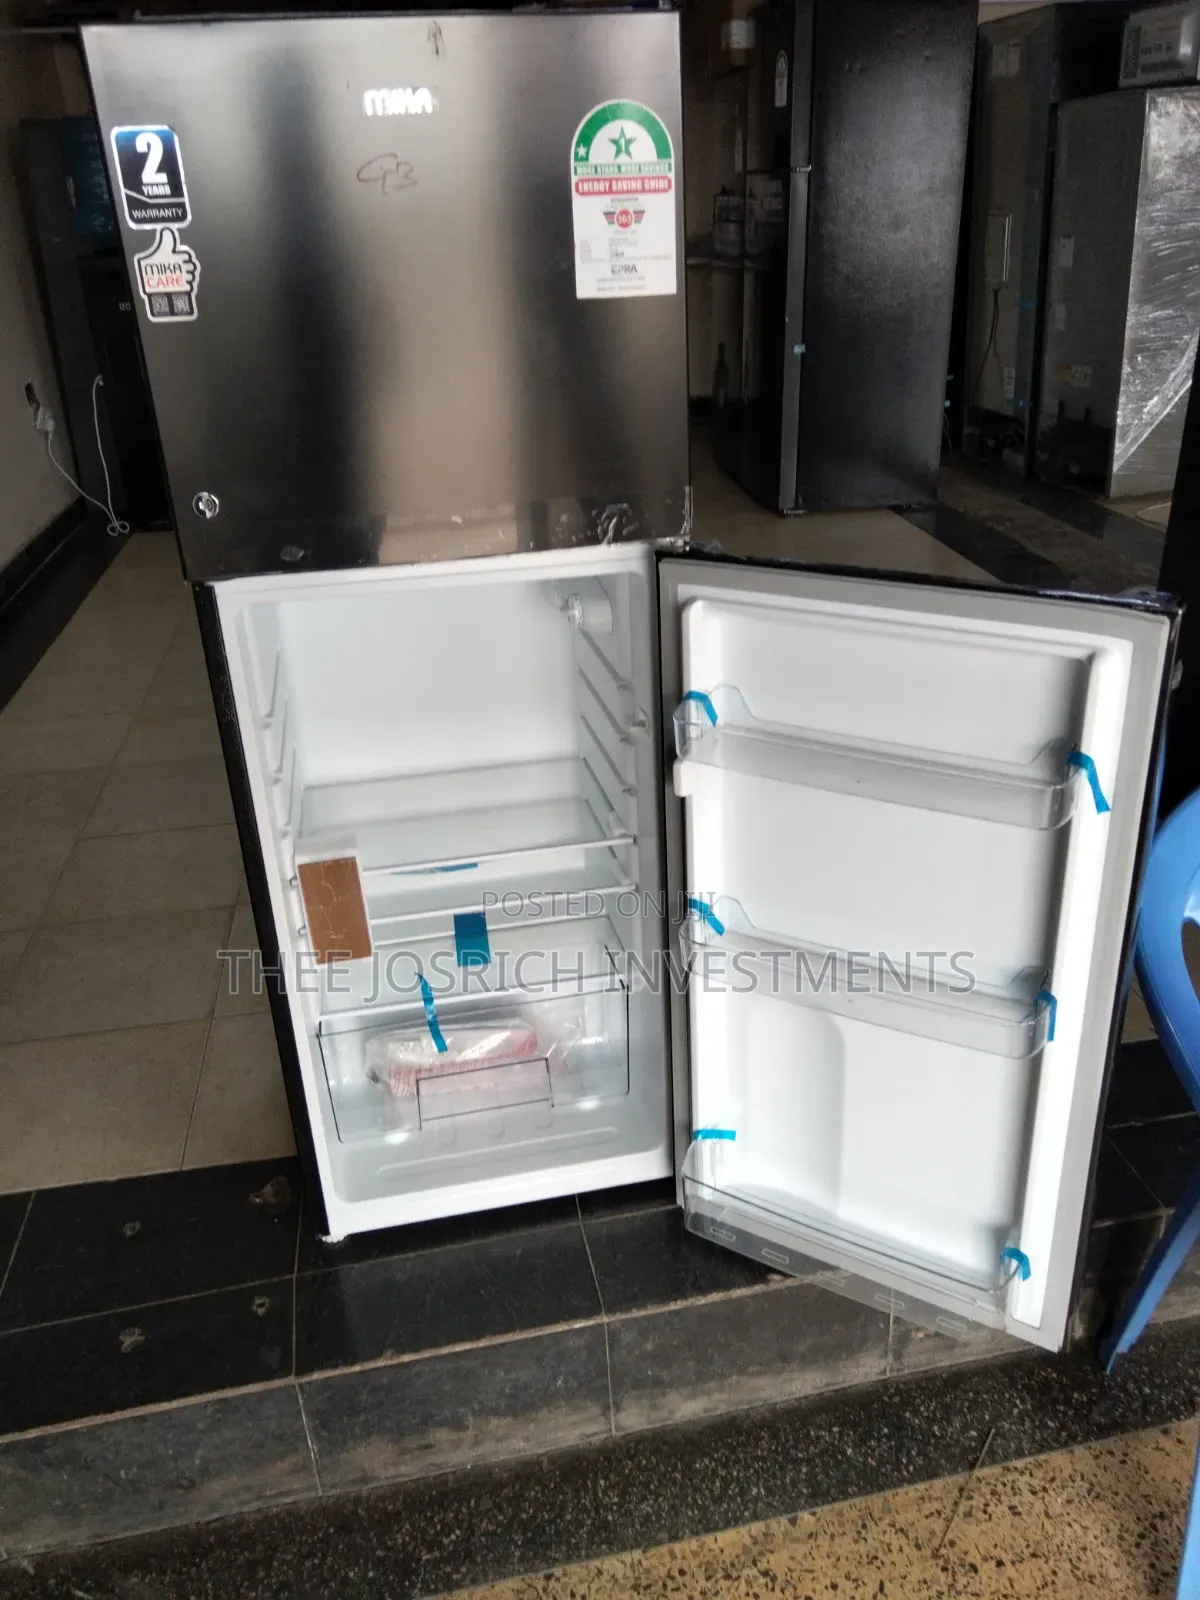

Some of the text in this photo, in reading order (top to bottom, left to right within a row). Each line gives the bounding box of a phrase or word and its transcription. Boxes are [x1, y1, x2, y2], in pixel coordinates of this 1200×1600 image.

[135, 131, 168, 184] 2
[142, 185, 172, 196] YEARS
[132, 206, 184, 220] WARRANTY
[144, 262, 183, 276] MIKA
[146, 275, 184, 288] CARE
